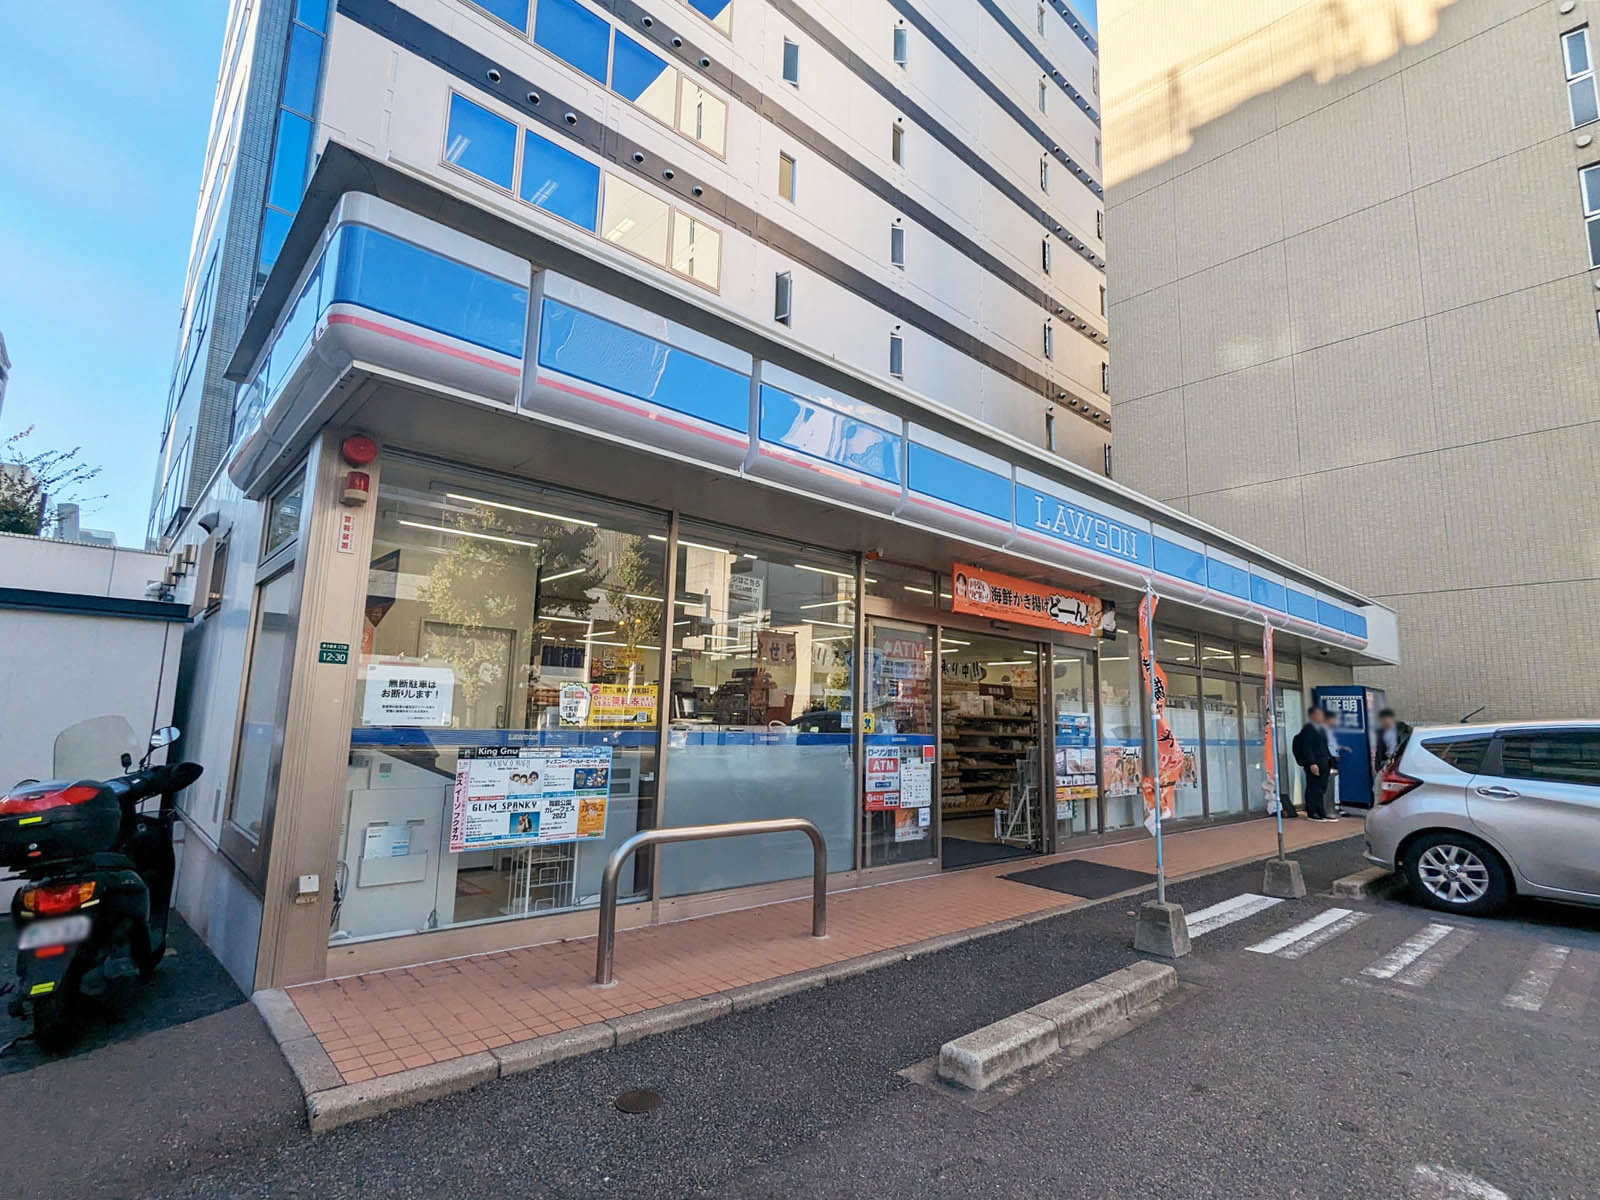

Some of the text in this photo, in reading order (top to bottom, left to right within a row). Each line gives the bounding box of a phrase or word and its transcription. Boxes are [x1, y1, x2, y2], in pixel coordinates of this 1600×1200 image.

[1033, 495, 1139, 559] LAWSON
[322, 652, 347, 662] 12-30
[388, 679, 437, 689] 無断駐車は
[478, 747, 498, 757] King
[500, 747, 519, 755] Gnu
[868, 748, 899, 757] ローソン銀行
[872, 761, 894, 772] ATM
[472, 800, 538, 812] GLIM SPANKY
[544, 805, 575, 814] カレーフェス
